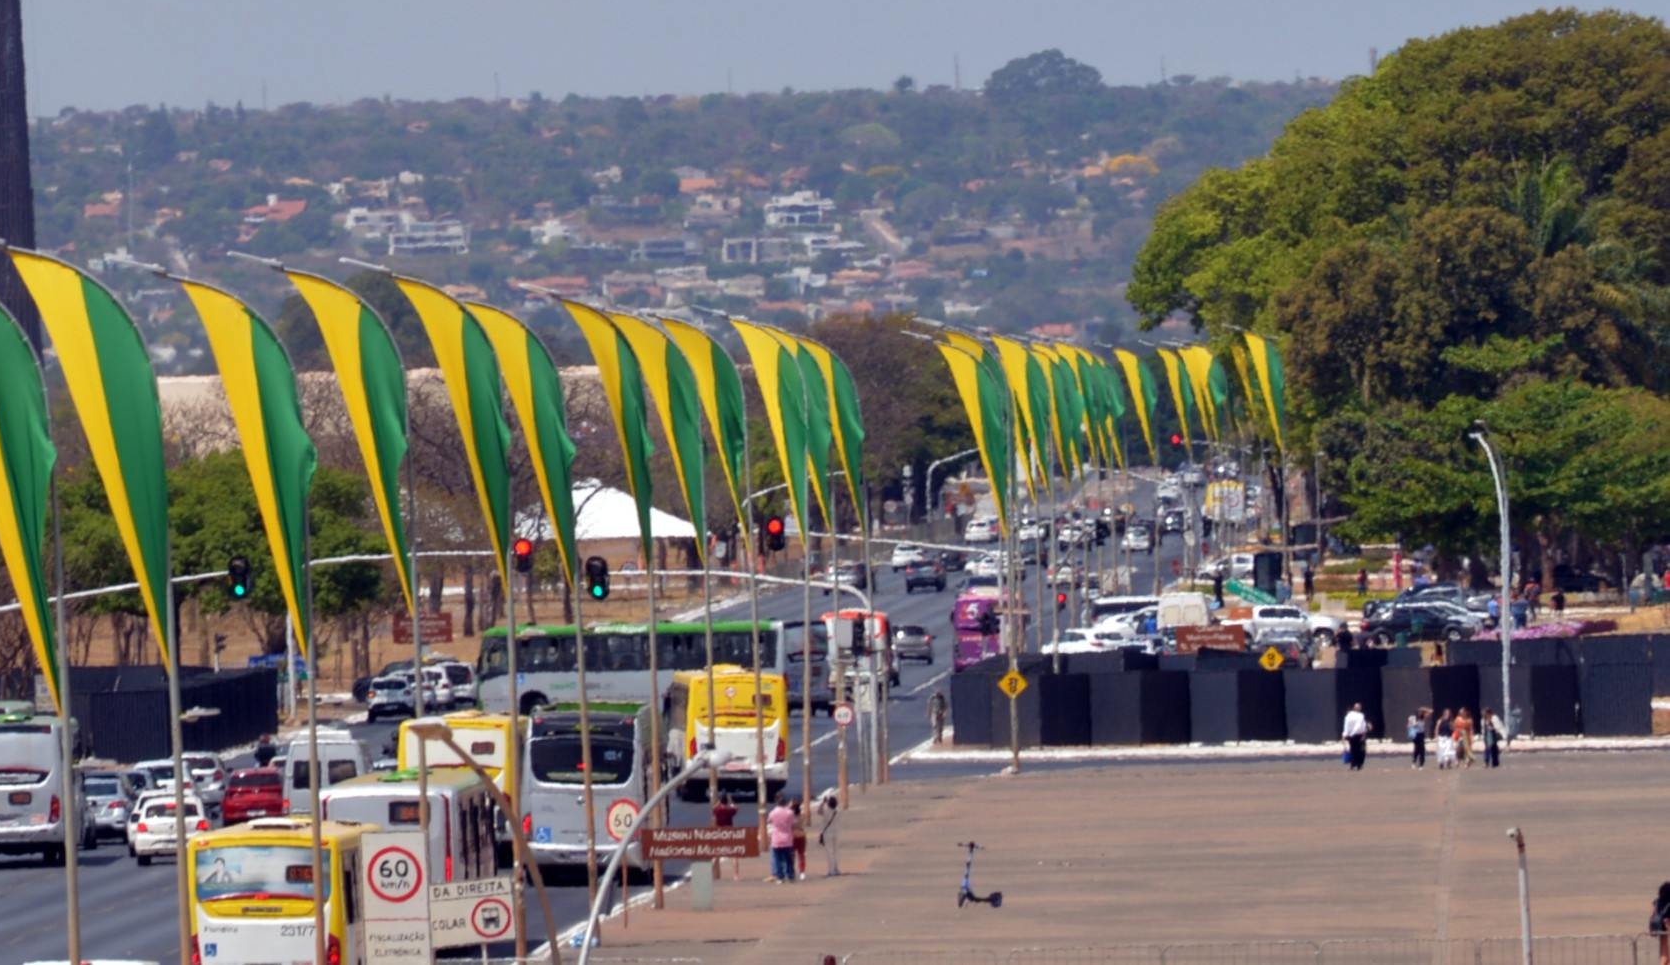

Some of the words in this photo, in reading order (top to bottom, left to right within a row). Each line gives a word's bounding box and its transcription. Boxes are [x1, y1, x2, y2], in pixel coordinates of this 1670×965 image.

[614, 813, 633, 828] 60
[379, 859, 409, 878] 60
[433, 888, 450, 898] DA
[457, 881, 506, 896] DIREITA
